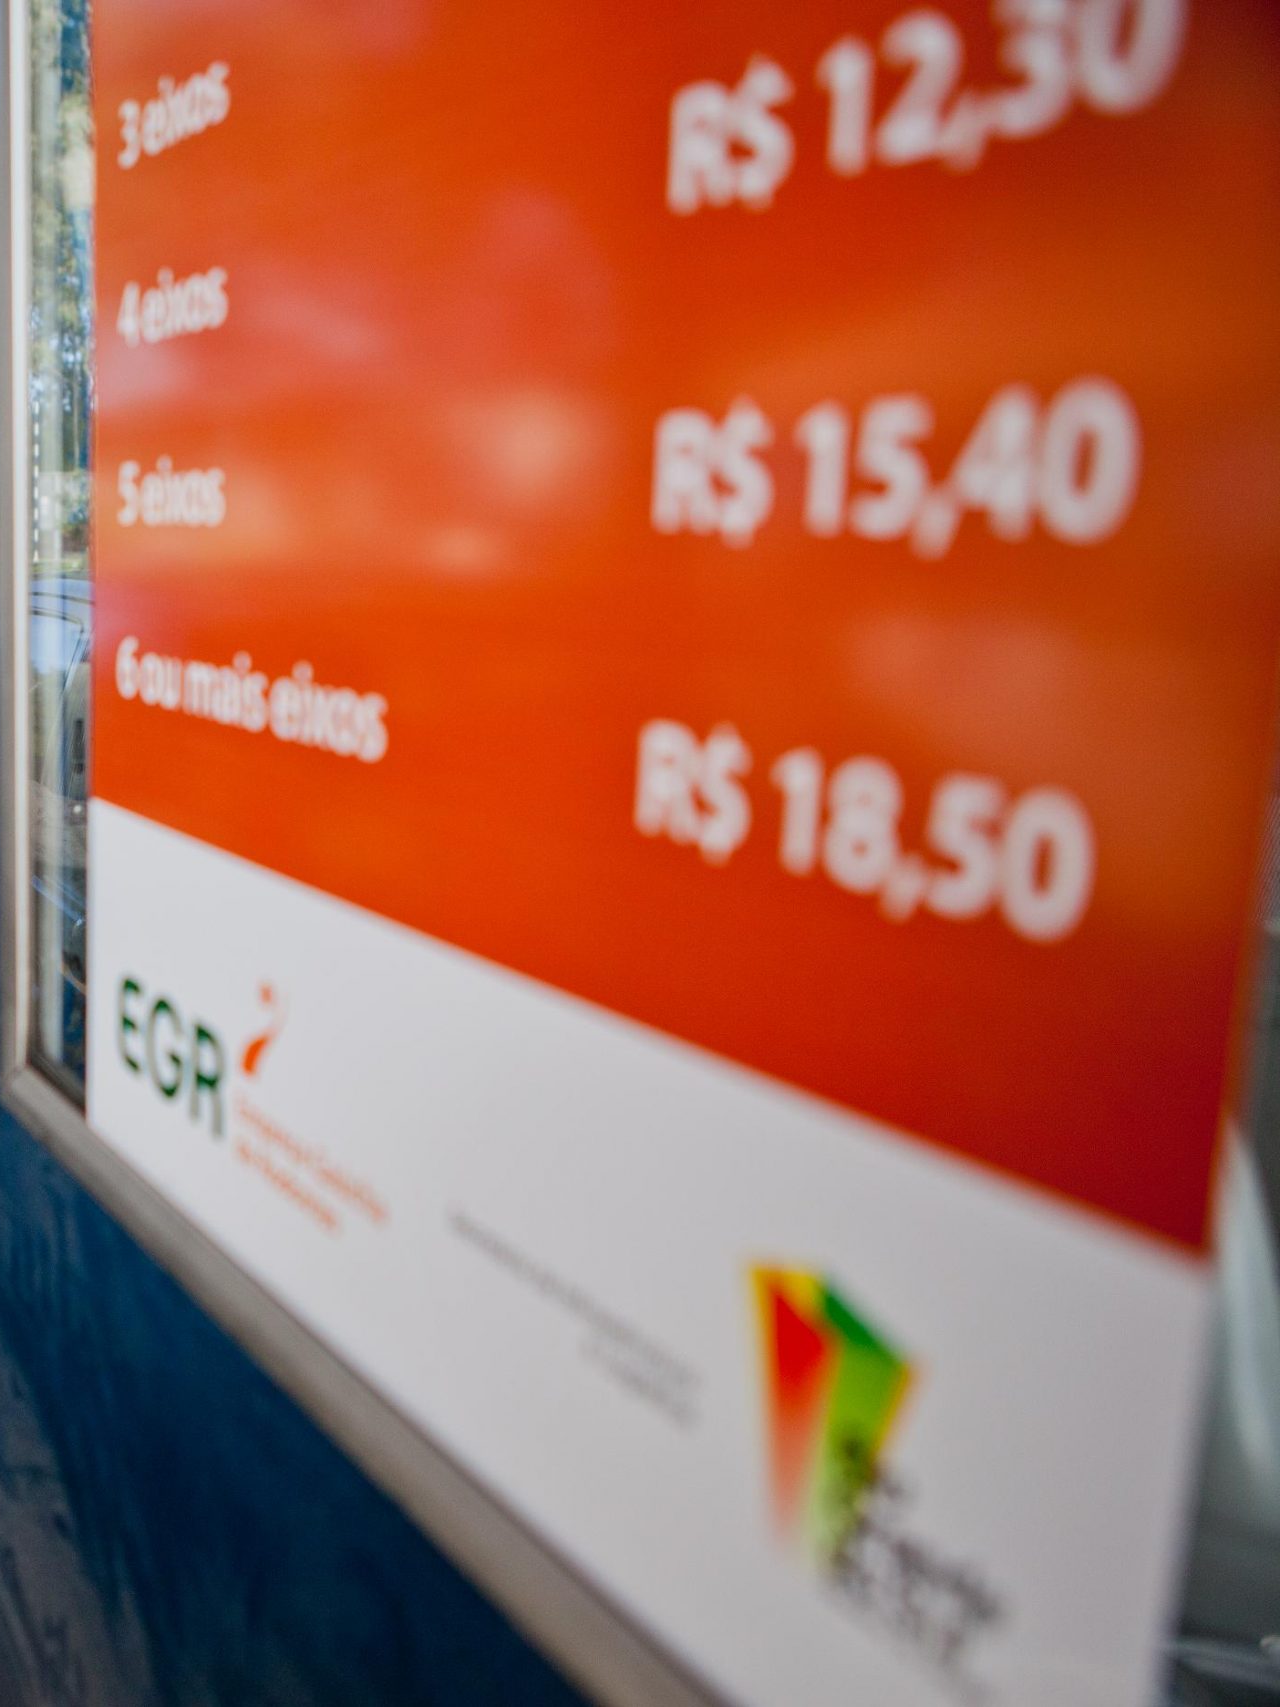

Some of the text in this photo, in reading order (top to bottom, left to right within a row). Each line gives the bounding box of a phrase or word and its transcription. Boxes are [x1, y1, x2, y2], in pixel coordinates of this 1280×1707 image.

[118, 61, 231, 170] 3 eixos
[668, 0, 1188, 216] R$ 12,30
[118, 268, 228, 346] 4 eixos
[118, 457, 226, 527] 5 eixos
[651, 375, 1142, 560] R$ 15,40
[115, 635, 389, 764] 6 ou mais eixos
[634, 717, 1096, 944] R$ 18,50
[118, 974, 224, 1139] EGR
